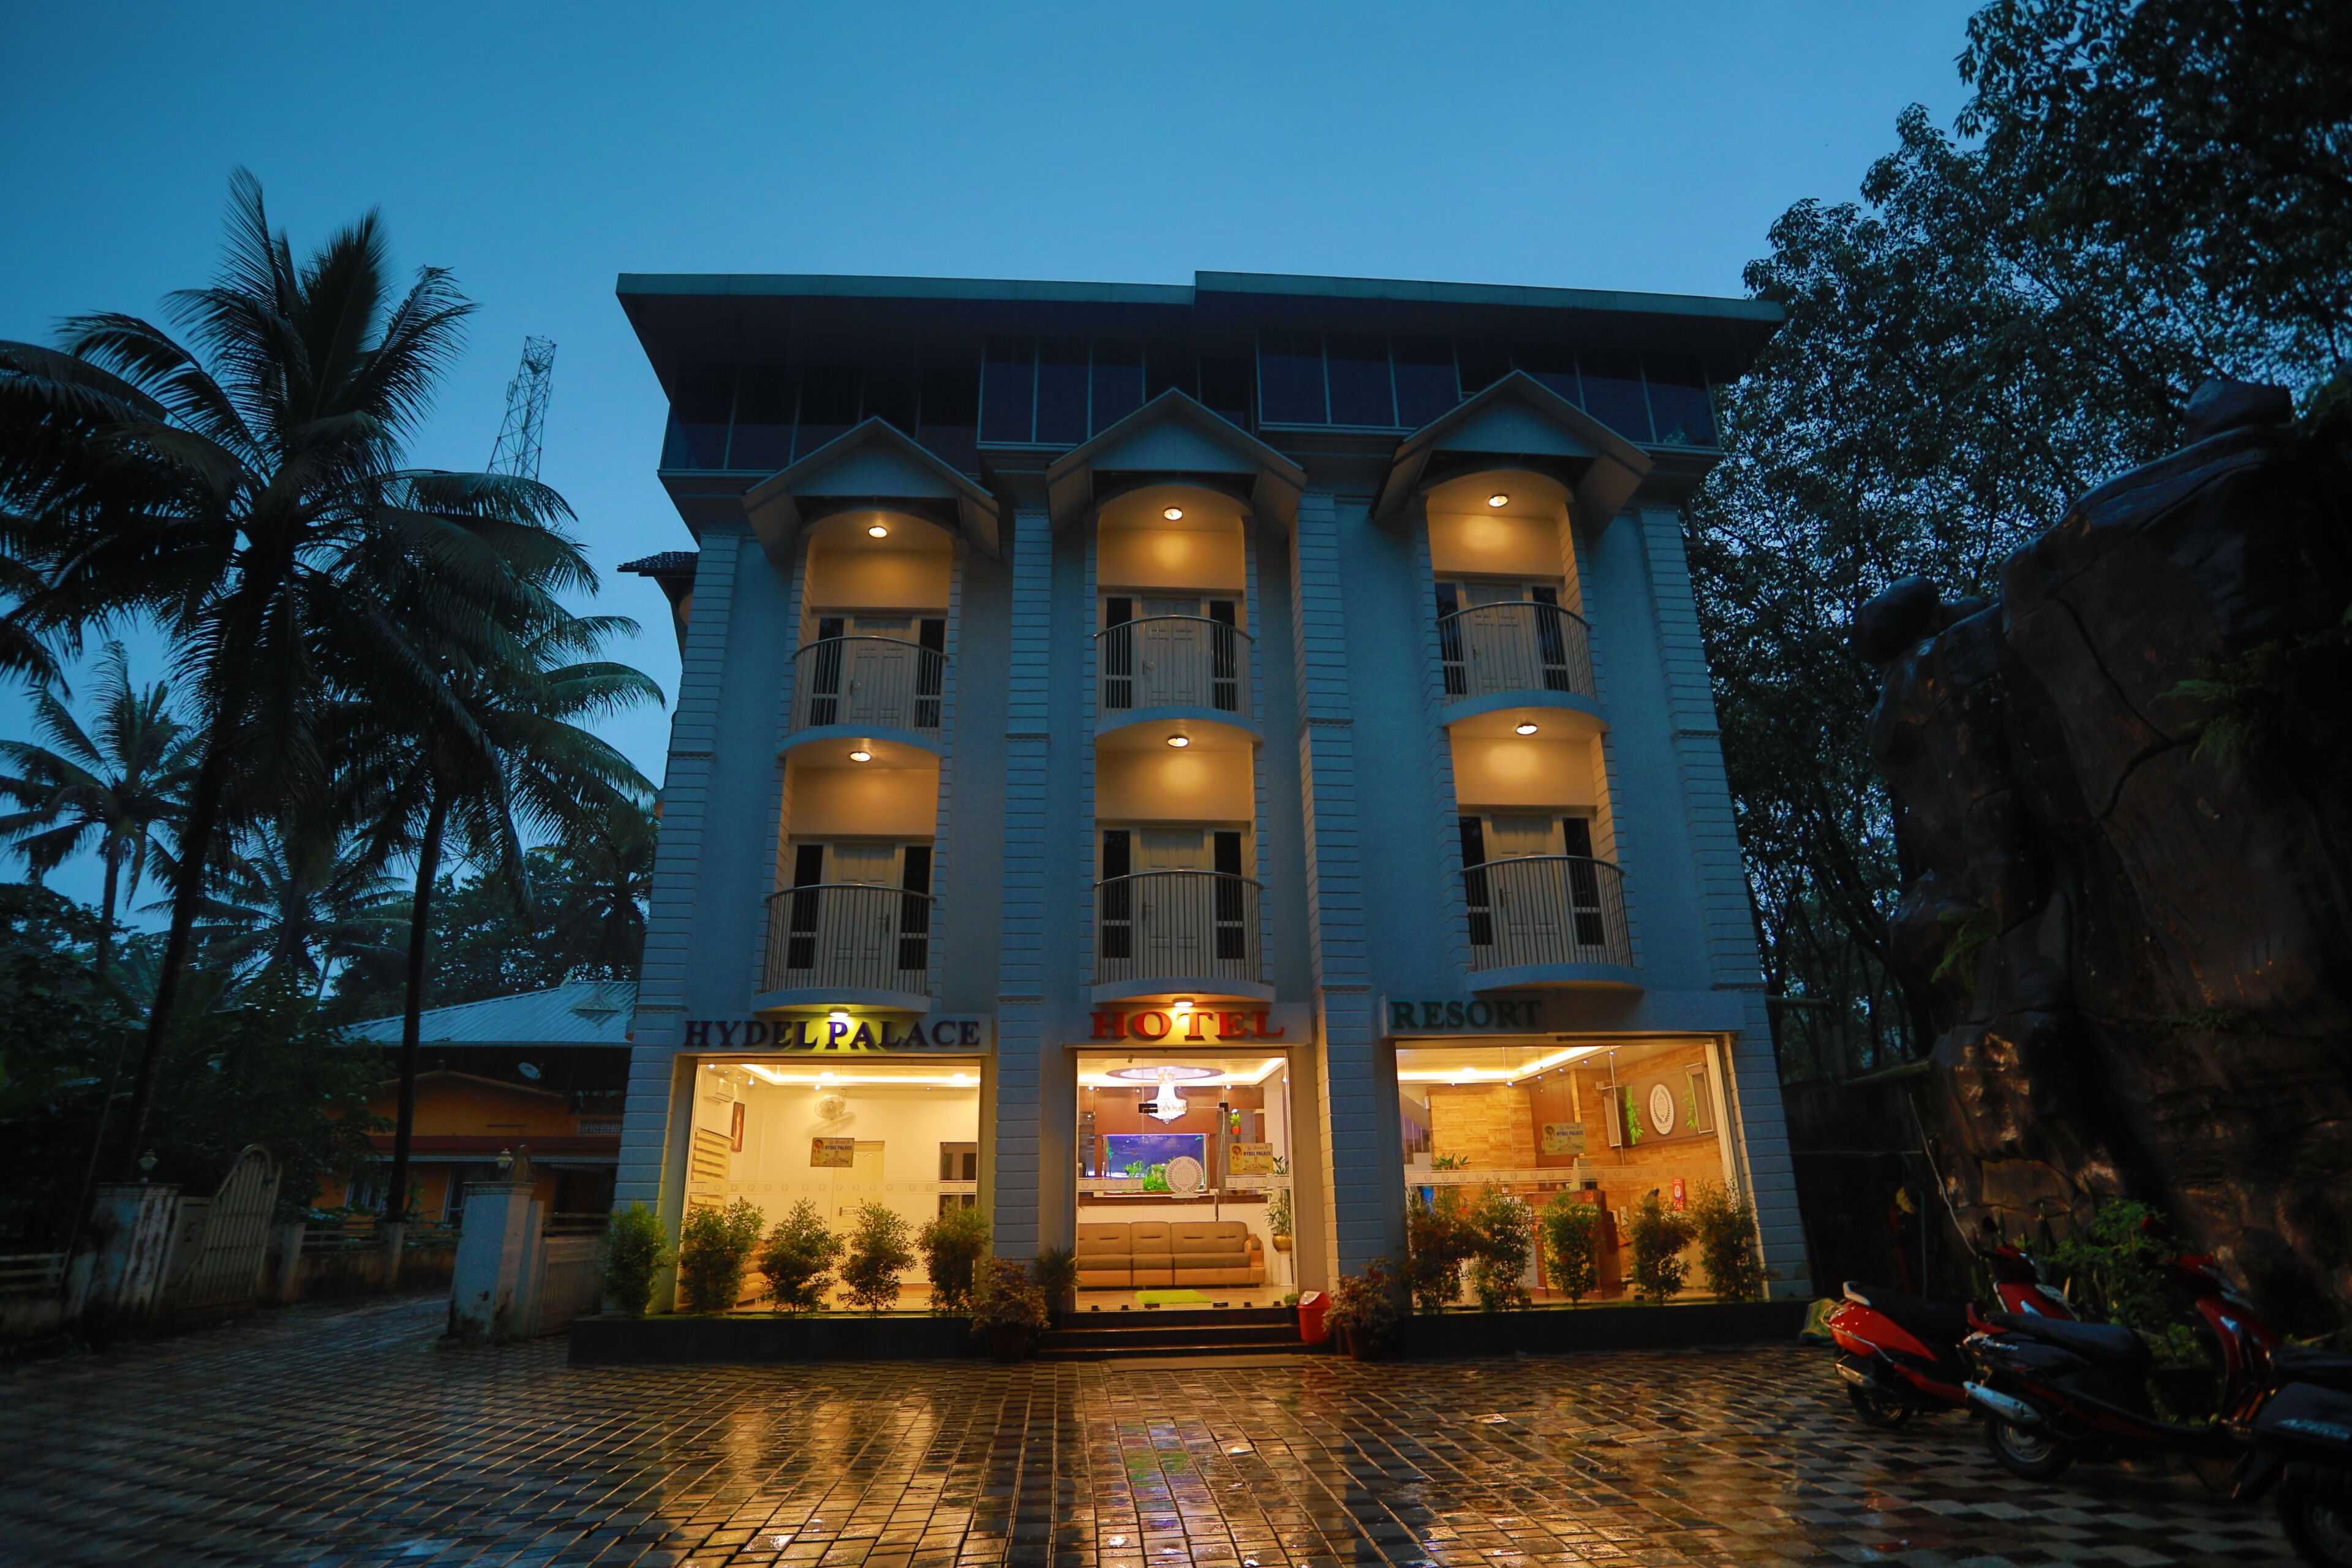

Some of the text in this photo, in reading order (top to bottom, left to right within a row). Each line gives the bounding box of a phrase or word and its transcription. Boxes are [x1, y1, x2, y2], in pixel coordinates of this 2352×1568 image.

[1089, 1011, 1284, 1041] HOTEL
[1390, 1000, 1542, 1030] RESORT
[683, 1020, 980, 1050] HYDEL PALACE
